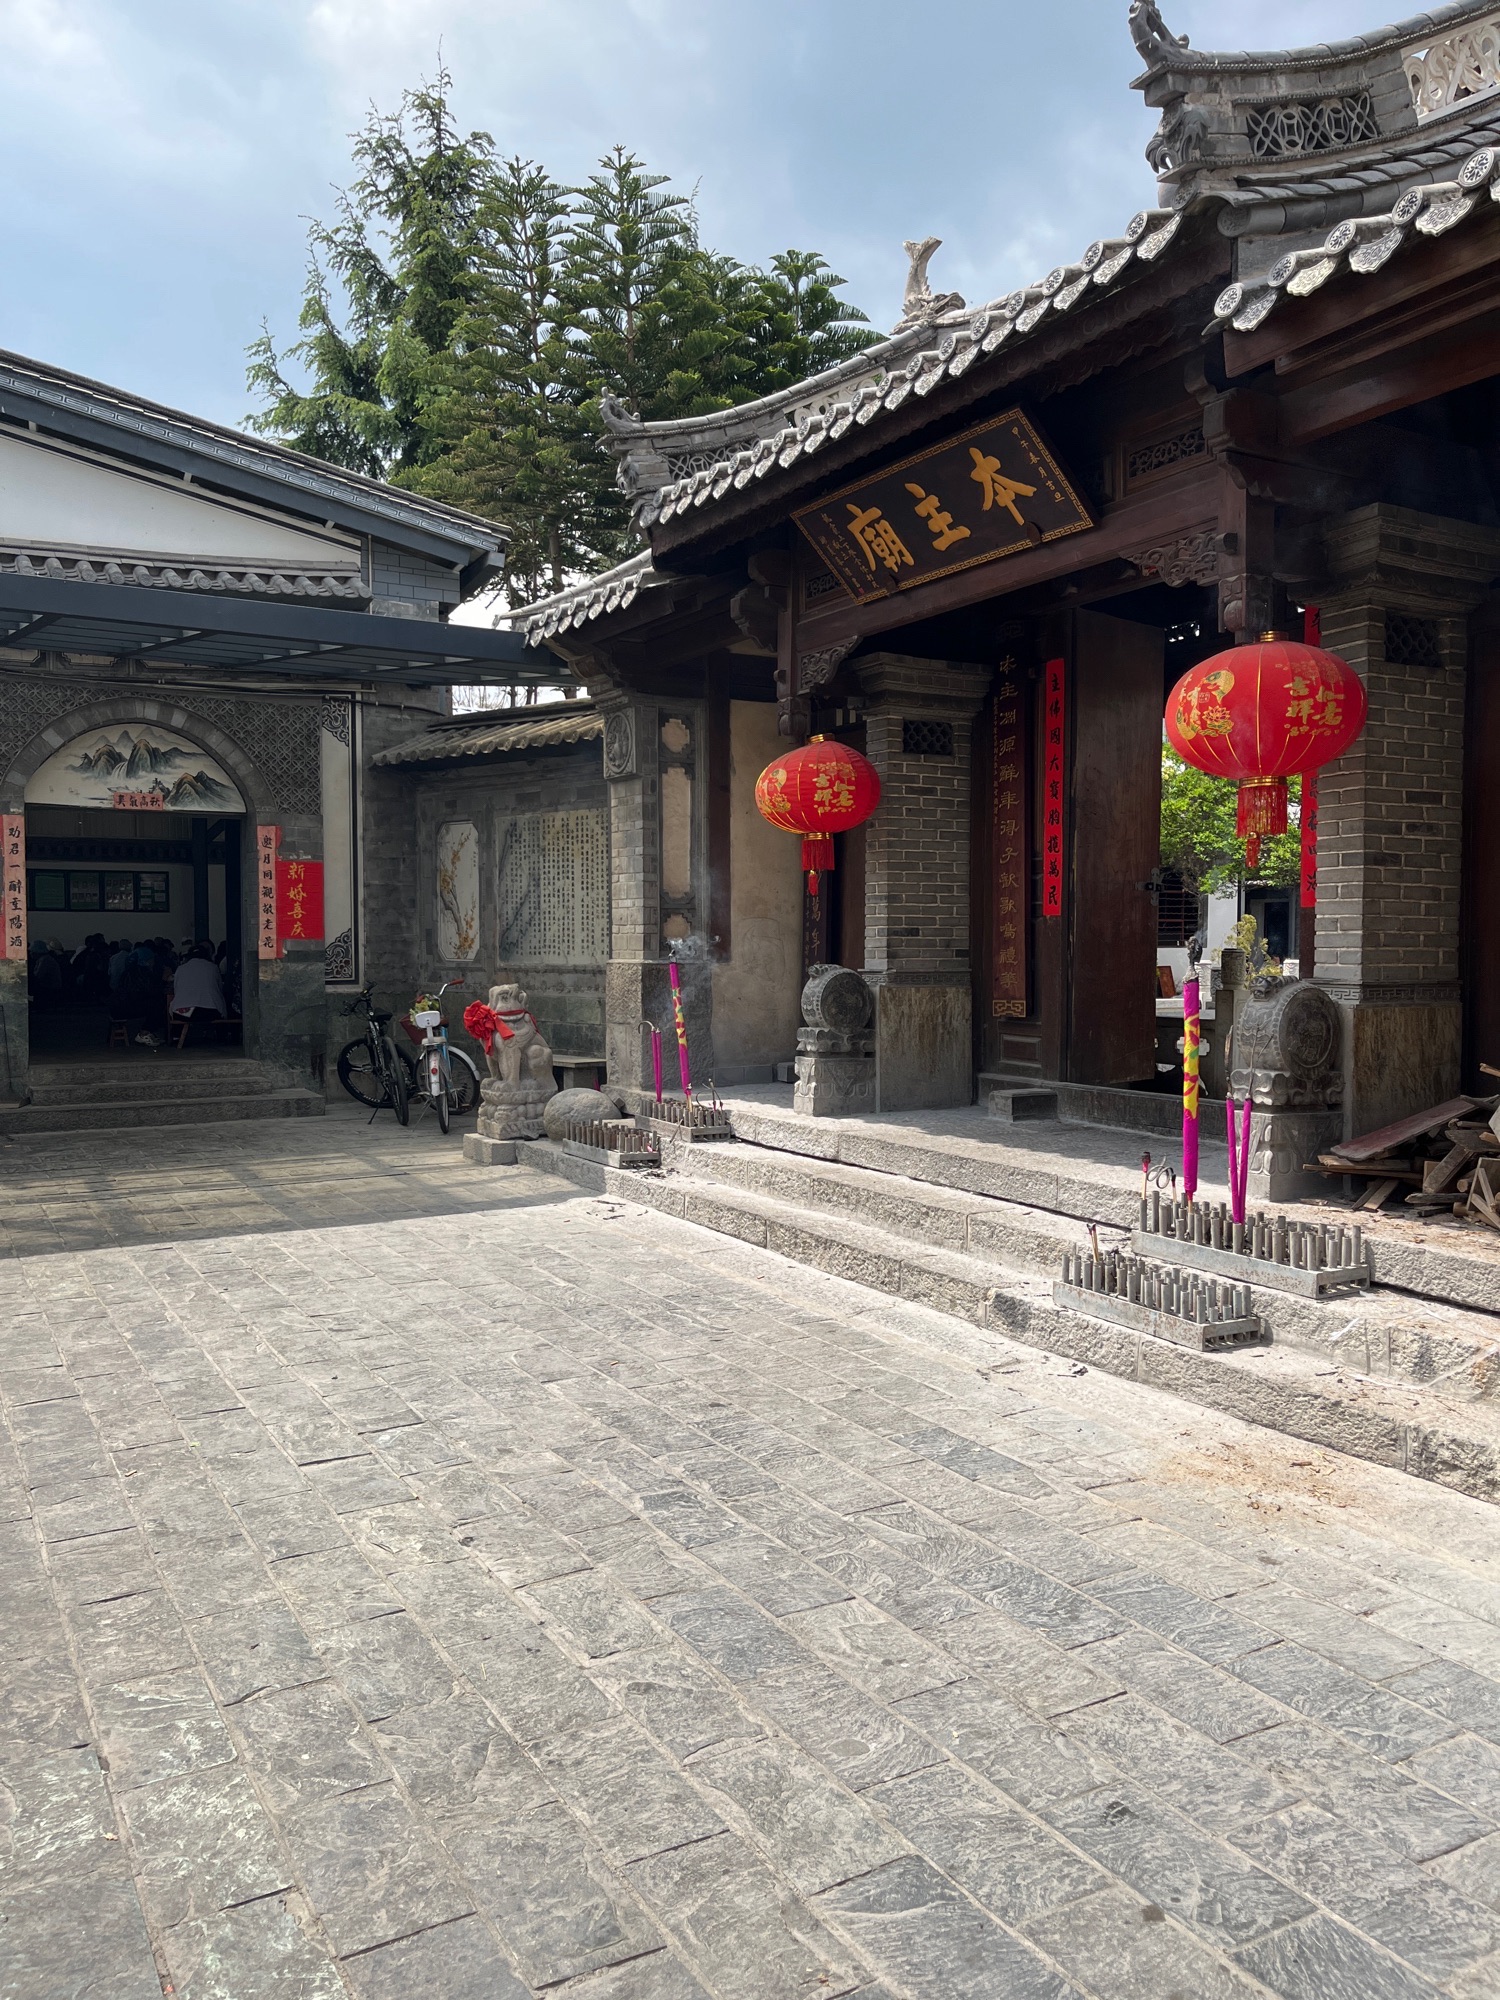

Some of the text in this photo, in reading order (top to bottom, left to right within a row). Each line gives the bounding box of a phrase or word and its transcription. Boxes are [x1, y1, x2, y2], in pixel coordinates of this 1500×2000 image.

[1011, 426, 1065, 503] 甲午春月吉旦
[845, 447, 1037, 574] 本主廟
[286, 862, 307, 938] 新婚喜庆
